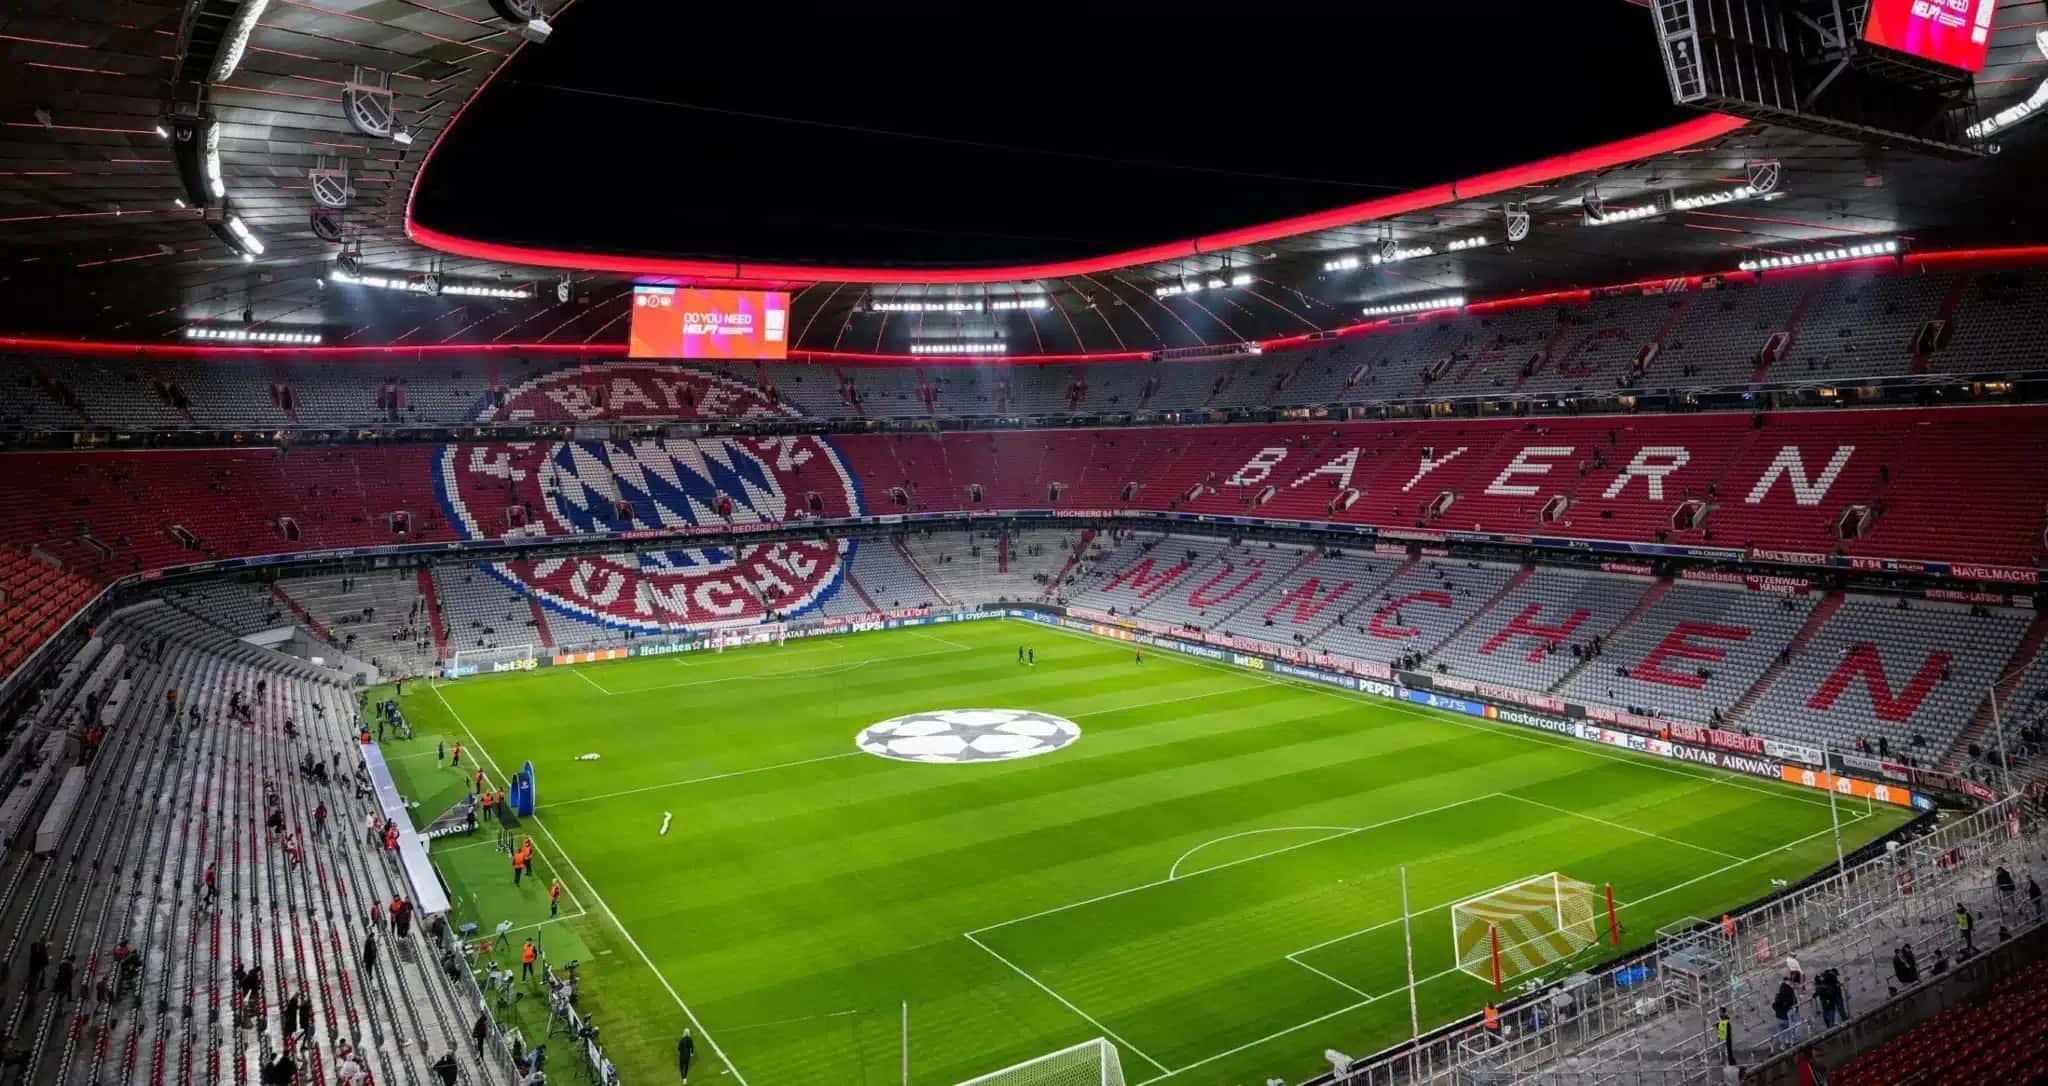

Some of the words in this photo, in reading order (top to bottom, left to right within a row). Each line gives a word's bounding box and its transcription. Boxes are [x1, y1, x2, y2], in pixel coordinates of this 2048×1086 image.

[683, 312, 700, 325] DO
[700, 312, 722, 325] YOU
[724, 313, 752, 325] NEED
[1225, 445, 1856, 506] BAYERN
[1752, 548, 1826, 564] AIGLSBACH
[1746, 575, 1809, 586] HOTZENWALD
[1952, 566, 2039, 583] HAVELMACHT
[965, 610, 1006, 620] crypto.com
[808, 626, 838, 637] AIRWAYS
[852, 622, 884, 633] PEPSI
[1101, 558, 1956, 722] MÜNCHEN
[640, 643, 692, 656] Heineken
[493, 657, 539, 673] bet365
[1234, 653, 1265, 670] bet365
[1359, 679, 1394, 698] PEPSI
[1439, 697, 1467, 712] PS5
[1500, 708, 1567, 732] mastercard
[1583, 725, 1616, 744] FedEx
[1709, 729, 1762, 753] TAUBERTAL
[1627, 735, 1661, 753] FedEx
[1673, 744, 1718, 765] QATAR
[1722, 755, 1781, 778] AIRWAYS
